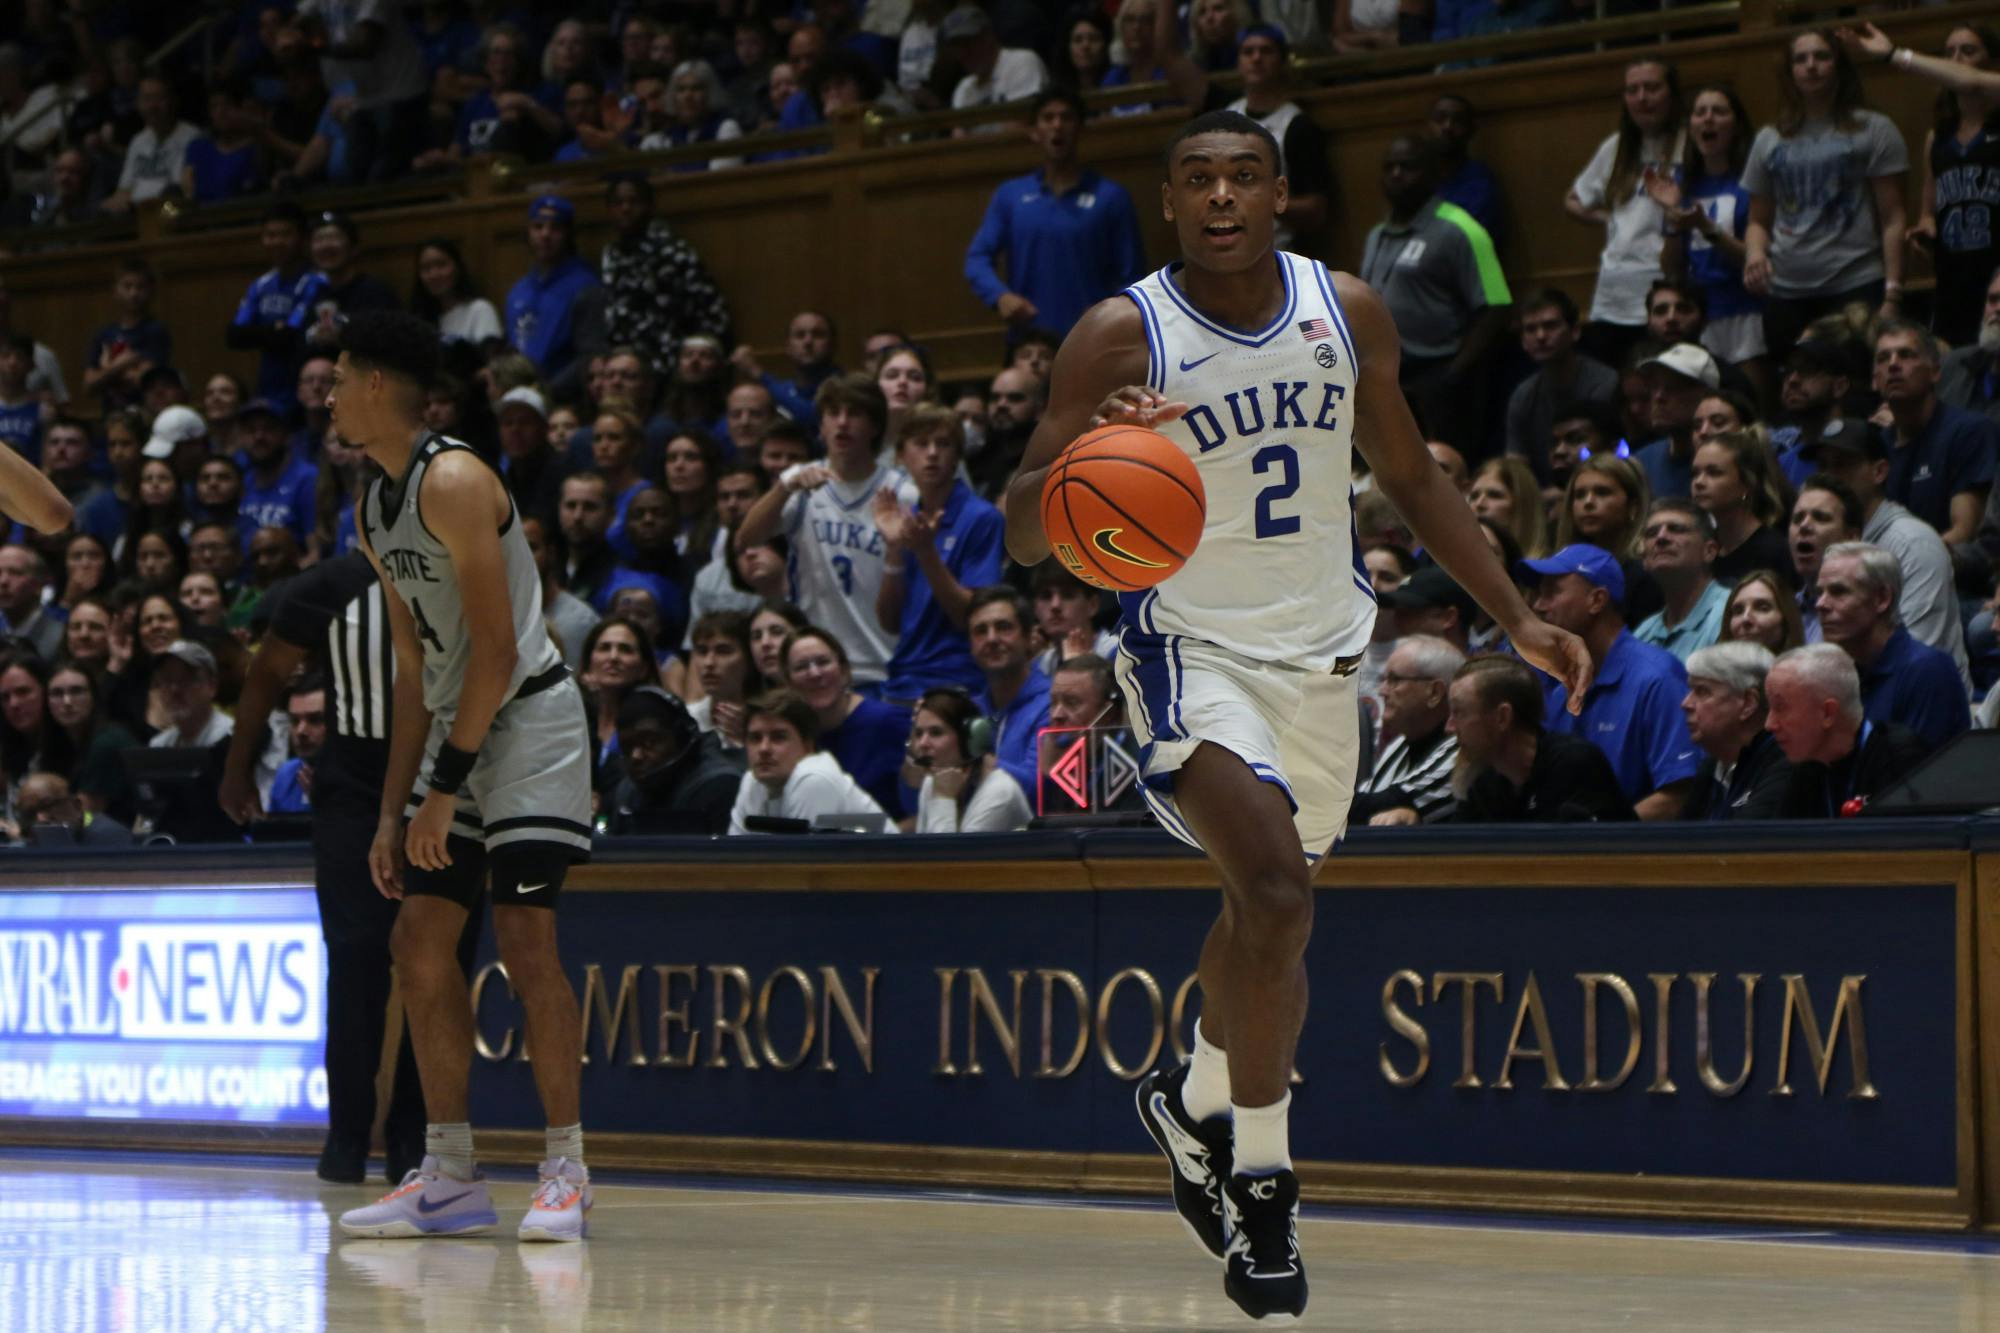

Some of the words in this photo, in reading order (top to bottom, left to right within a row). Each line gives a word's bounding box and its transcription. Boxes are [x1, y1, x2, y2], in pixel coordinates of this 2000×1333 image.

[1181, 381, 1346, 452] DUKE
[1252, 444, 1300, 539] 2
[137, 940, 308, 1026] NEWS
[470, 961, 882, 1075] CMERON
[1378, 968, 1881, 1101] STADIUM
[84, 1063, 142, 1105] YOU
[147, 1063, 203, 1106] CAN
[208, 1066, 304, 1108] COUNT
